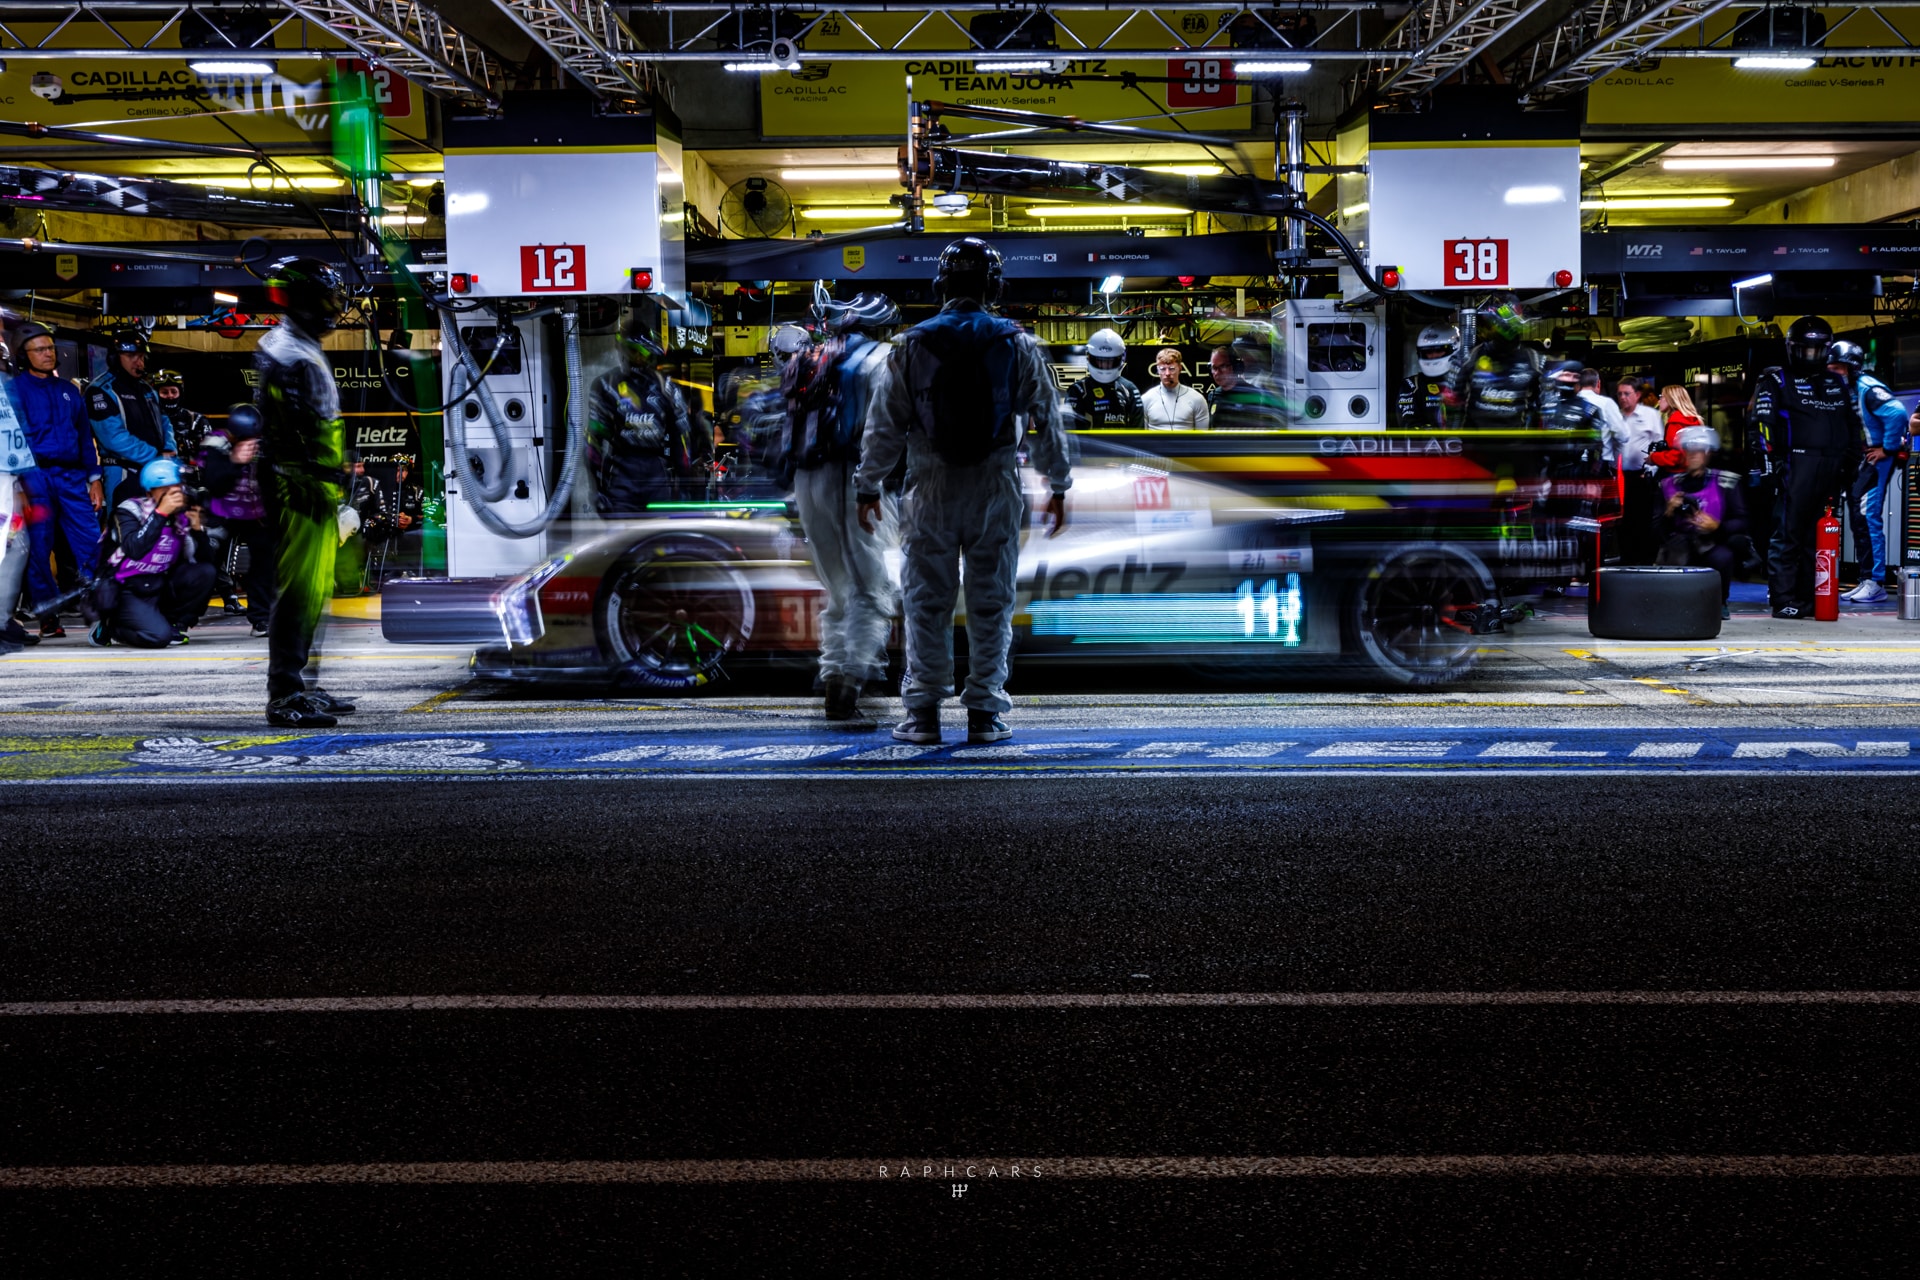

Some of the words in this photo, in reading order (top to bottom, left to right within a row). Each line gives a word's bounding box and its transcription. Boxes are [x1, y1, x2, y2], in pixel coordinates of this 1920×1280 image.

[1183, 17, 1206, 29] FIA
[71, 71, 190, 86] CADILLAC
[1183, 59, 1221, 94] 38
[1604, 77, 1675, 86] CADILLAC
[1784, 79, 1827, 87] Cadillac
[355, 70, 393, 103] 12
[773, 86, 847, 95] CADILLAC
[938, 77, 1007, 91] TEAM
[1012, 77, 1074, 91] JOTA
[956, 97, 998, 106] Cadillac
[1000, 96, 1056, 105] V-Series.R
[126, 107, 169, 116] Cadillac
[1626, 244, 1664, 256] WTR
[532, 247, 576, 288] 12
[1454, 241, 1499, 282] 38
[1800, 398, 1846, 408] CADILLAC
[355, 426, 409, 443] Hertz
[1318, 437, 1465, 455] CADILLAC
[1135, 481, 1166, 506] HY
[630, 664, 687, 688] MICHELIN
